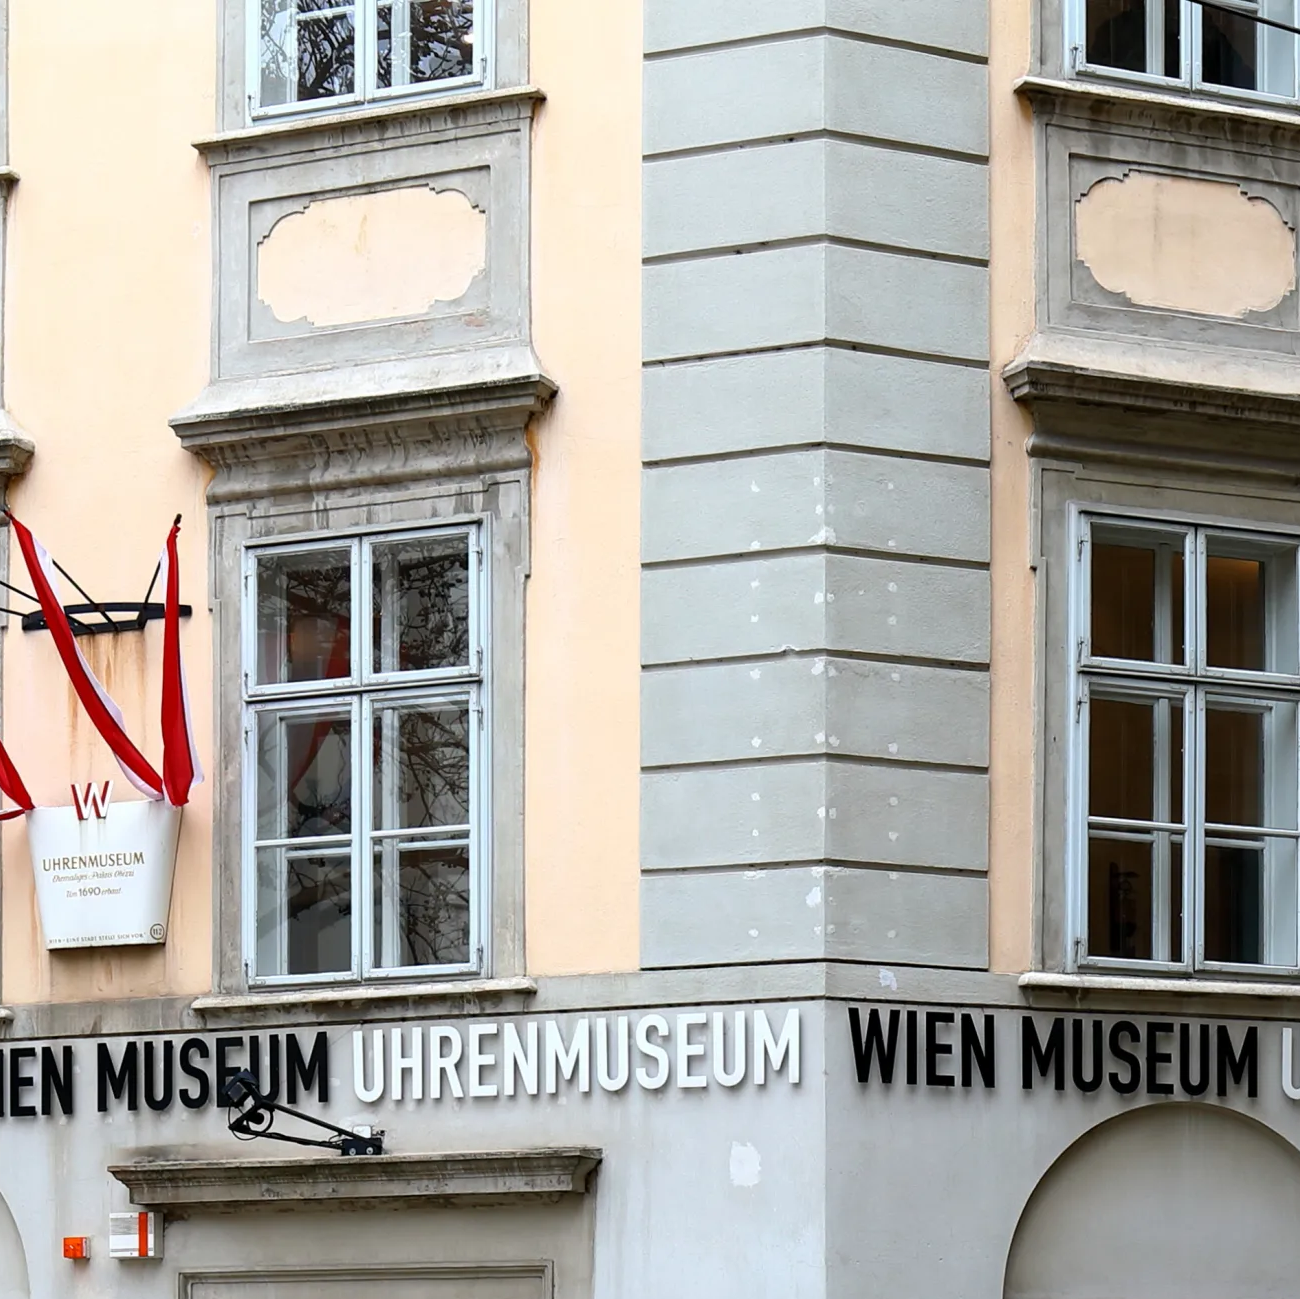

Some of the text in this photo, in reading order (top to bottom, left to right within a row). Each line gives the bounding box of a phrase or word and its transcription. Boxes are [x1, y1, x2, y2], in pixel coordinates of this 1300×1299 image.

[71, 780, 114, 821] W
[42, 851, 145, 872] UHRENMUSEUM
[78, 886, 101, 897] 1690
[97, 1031, 329, 1112] MUSEUM
[352, 1008, 801, 1103] UHRENMUSEUM
[848, 1007, 996, 1089] WIEN
[1021, 1015, 1259, 1098] MUSEUM
